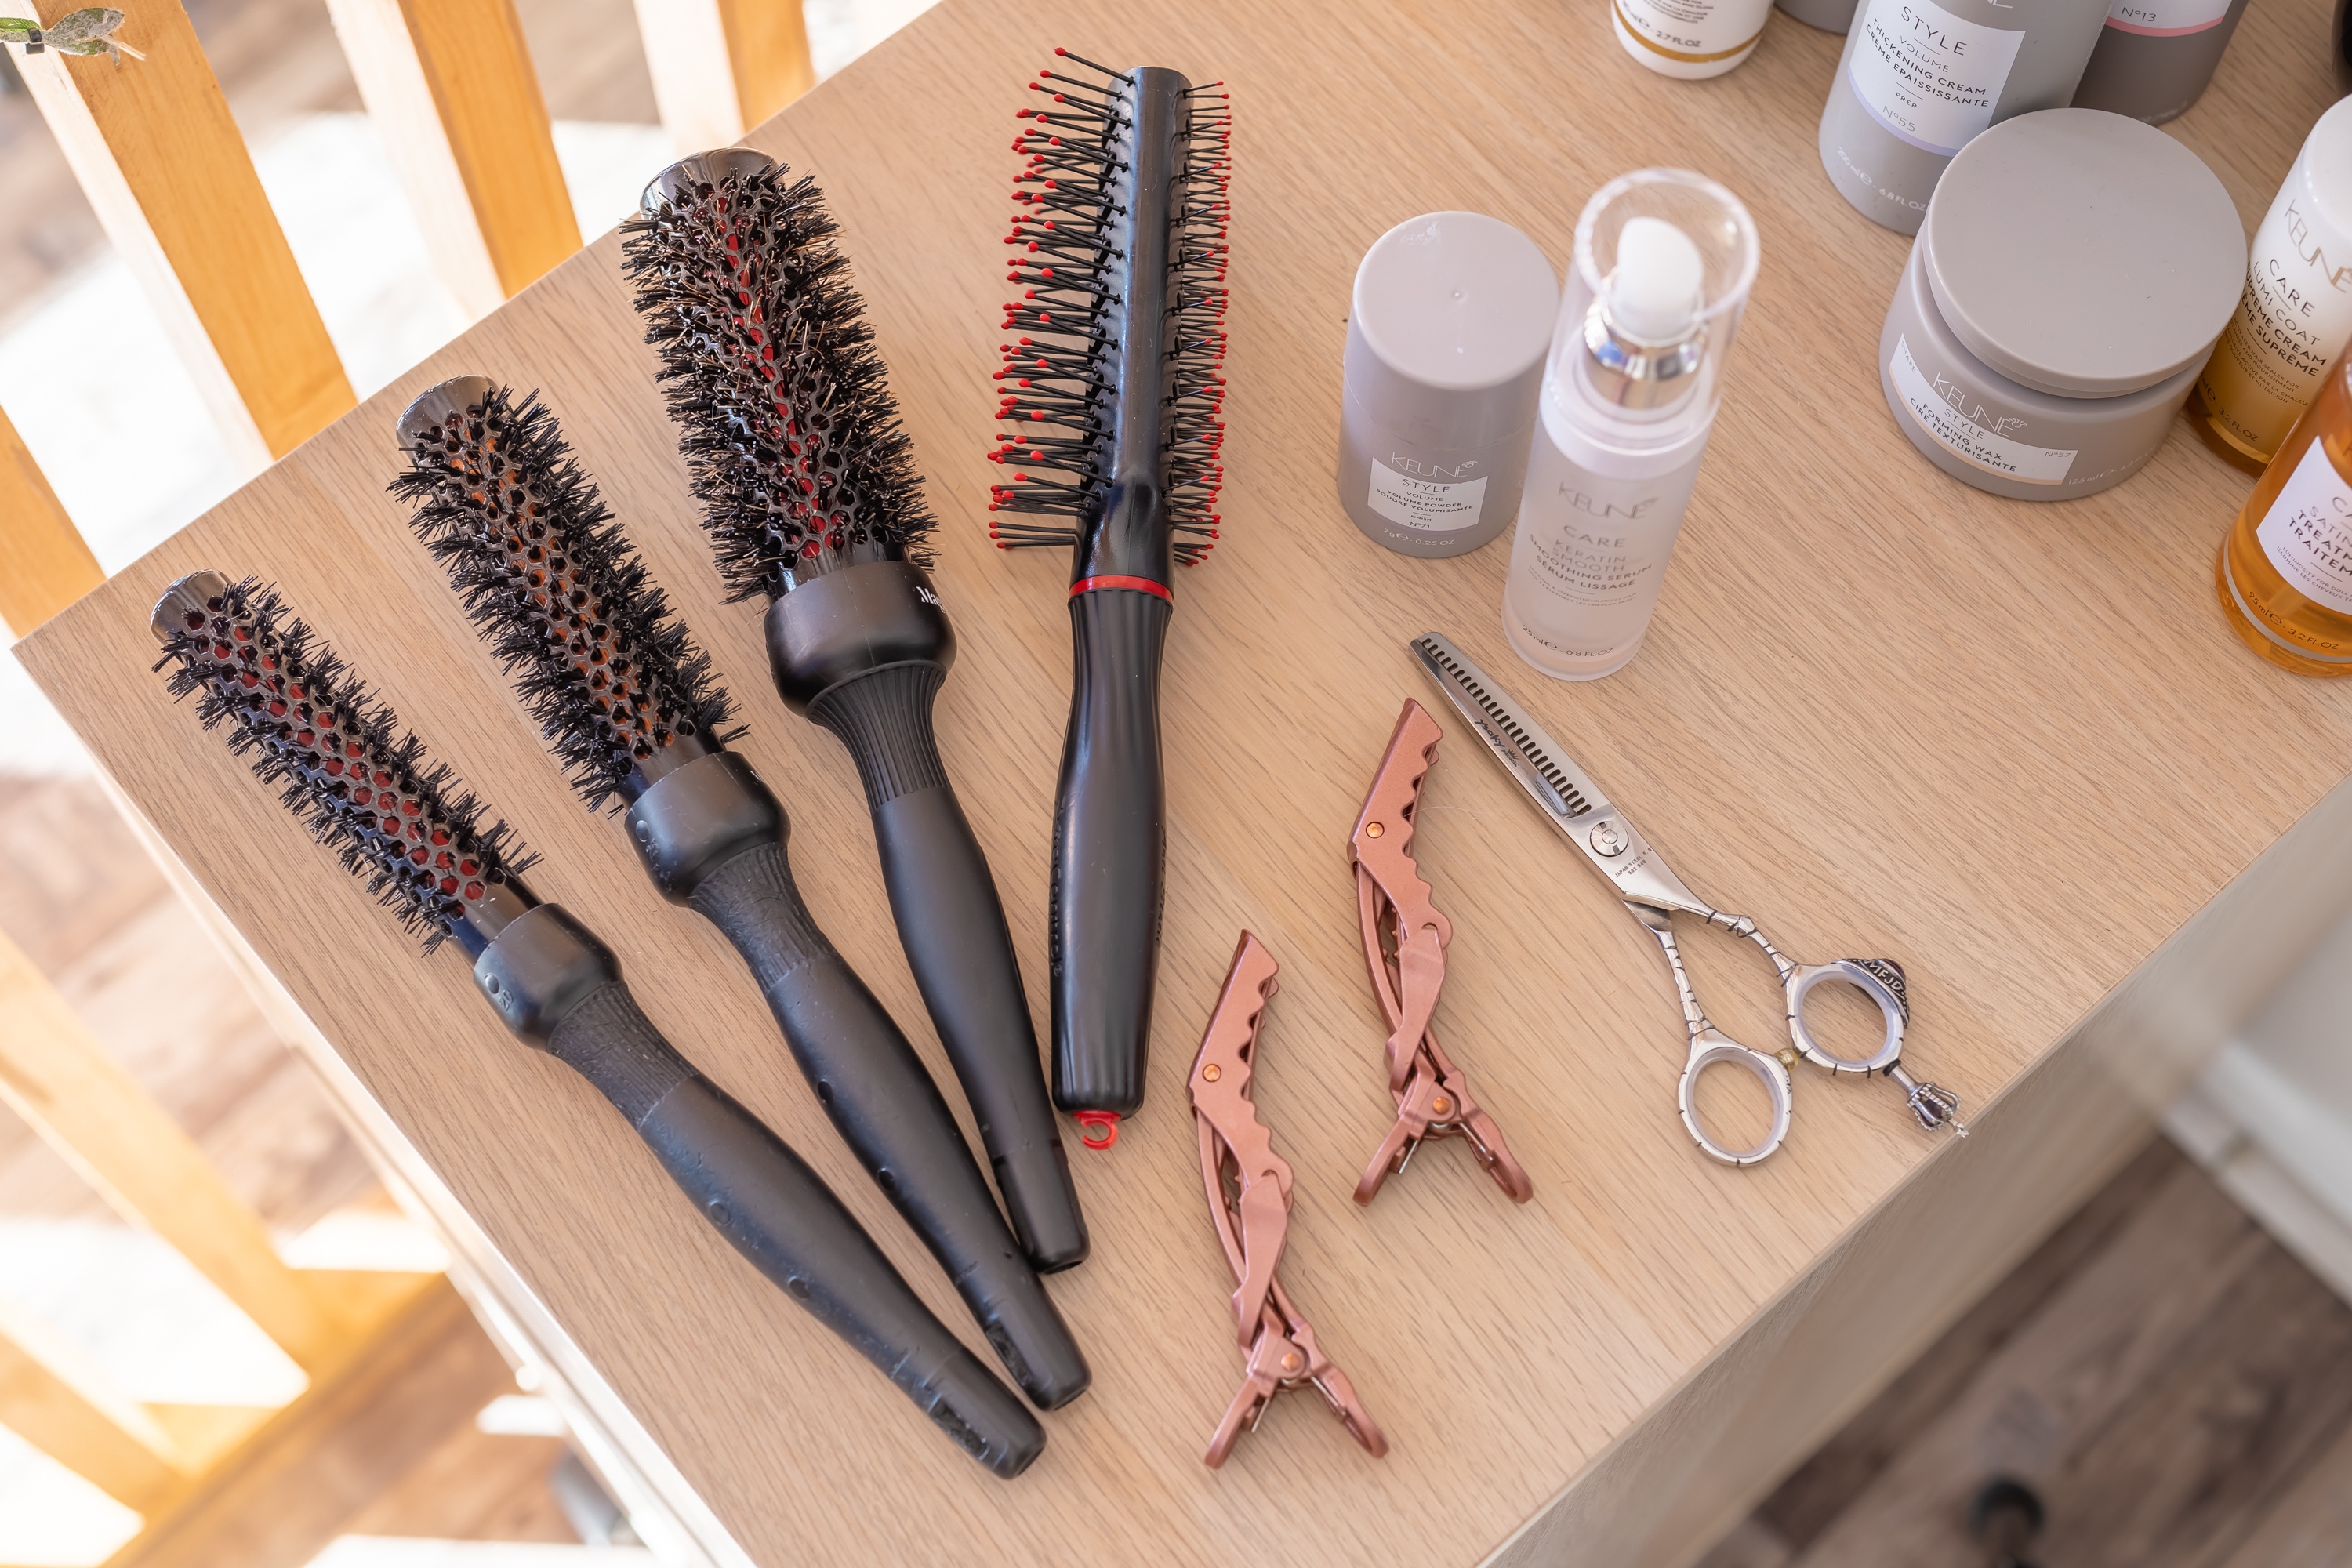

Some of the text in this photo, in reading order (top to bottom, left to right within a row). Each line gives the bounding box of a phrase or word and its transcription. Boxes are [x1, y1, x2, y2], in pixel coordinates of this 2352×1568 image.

[1900, 6, 1968, 56] STYLE
[1873, 17, 1987, 95] THICKENING CREAM
[1900, 36, 1951, 73] VOLUME
[1893, 63, 1989, 107] EPAISSISSANTE
[1895, 92, 1918, 107] PREP
[2254, 261, 2320, 345] LUMI COAT
[2270, 259, 2315, 318] CARE
[1901, 340, 1915, 373] SHAPE
[2256, 325, 2319, 376] SUPRÊME
[2274, 328, 2327, 366] CREAM
[2243, 346, 2252, 360] AND
[2252, 360, 2296, 393] NOURISHMENT
[2251, 349, 2263, 364] HAIR
[2263, 363, 2285, 380] SEALER
[2285, 379, 2299, 390] FOR
[1933, 371, 2013, 438] KEUNE
[2255, 379, 2288, 404] NUTRITION
[2259, 375, 2270, 387] PAR
[2280, 391, 2308, 406] CHALEU
[1910, 397, 2016, 472] CIRE TEXTURISANTE
[1922, 403, 2003, 460] FORMING WAX
[1944, 408, 1985, 440] STYLE
[1391, 452, 1469, 477] KEUNE
[1376, 488, 1408, 507] POUDRE
[1387, 489, 1421, 505] VOLUME
[1402, 478, 1451, 493] STYLE
[1406, 492, 1443, 502] VOLUME
[1558, 481, 1647, 520] KEUNE
[1555, 539, 1626, 563] KERATIN
[1563, 525, 1626, 548] CARE
[1530, 534, 1602, 581] SMOOTHING
[1607, 564, 1652, 581] SERUM
[1537, 555, 1575, 584] SERUM
[1580, 579, 1636, 590] LISSAGE
[1552, 547, 1625, 572] SMOOTH
[2277, 546, 2300, 573] ILLUMINE
[2300, 572, 2310, 583] LES
[2311, 581, 2343, 599] CHEVEUX
[2282, 546, 2349, 597] LUMINOSITY FOR DULL
[1523, 624, 1534, 637] 25
[2249, 590, 2259, 605] 95
[2288, 627, 2306, 641] 3.2
[1615, 865, 1629, 878] JAPAN
[1628, 855, 1643, 867] STEEL
